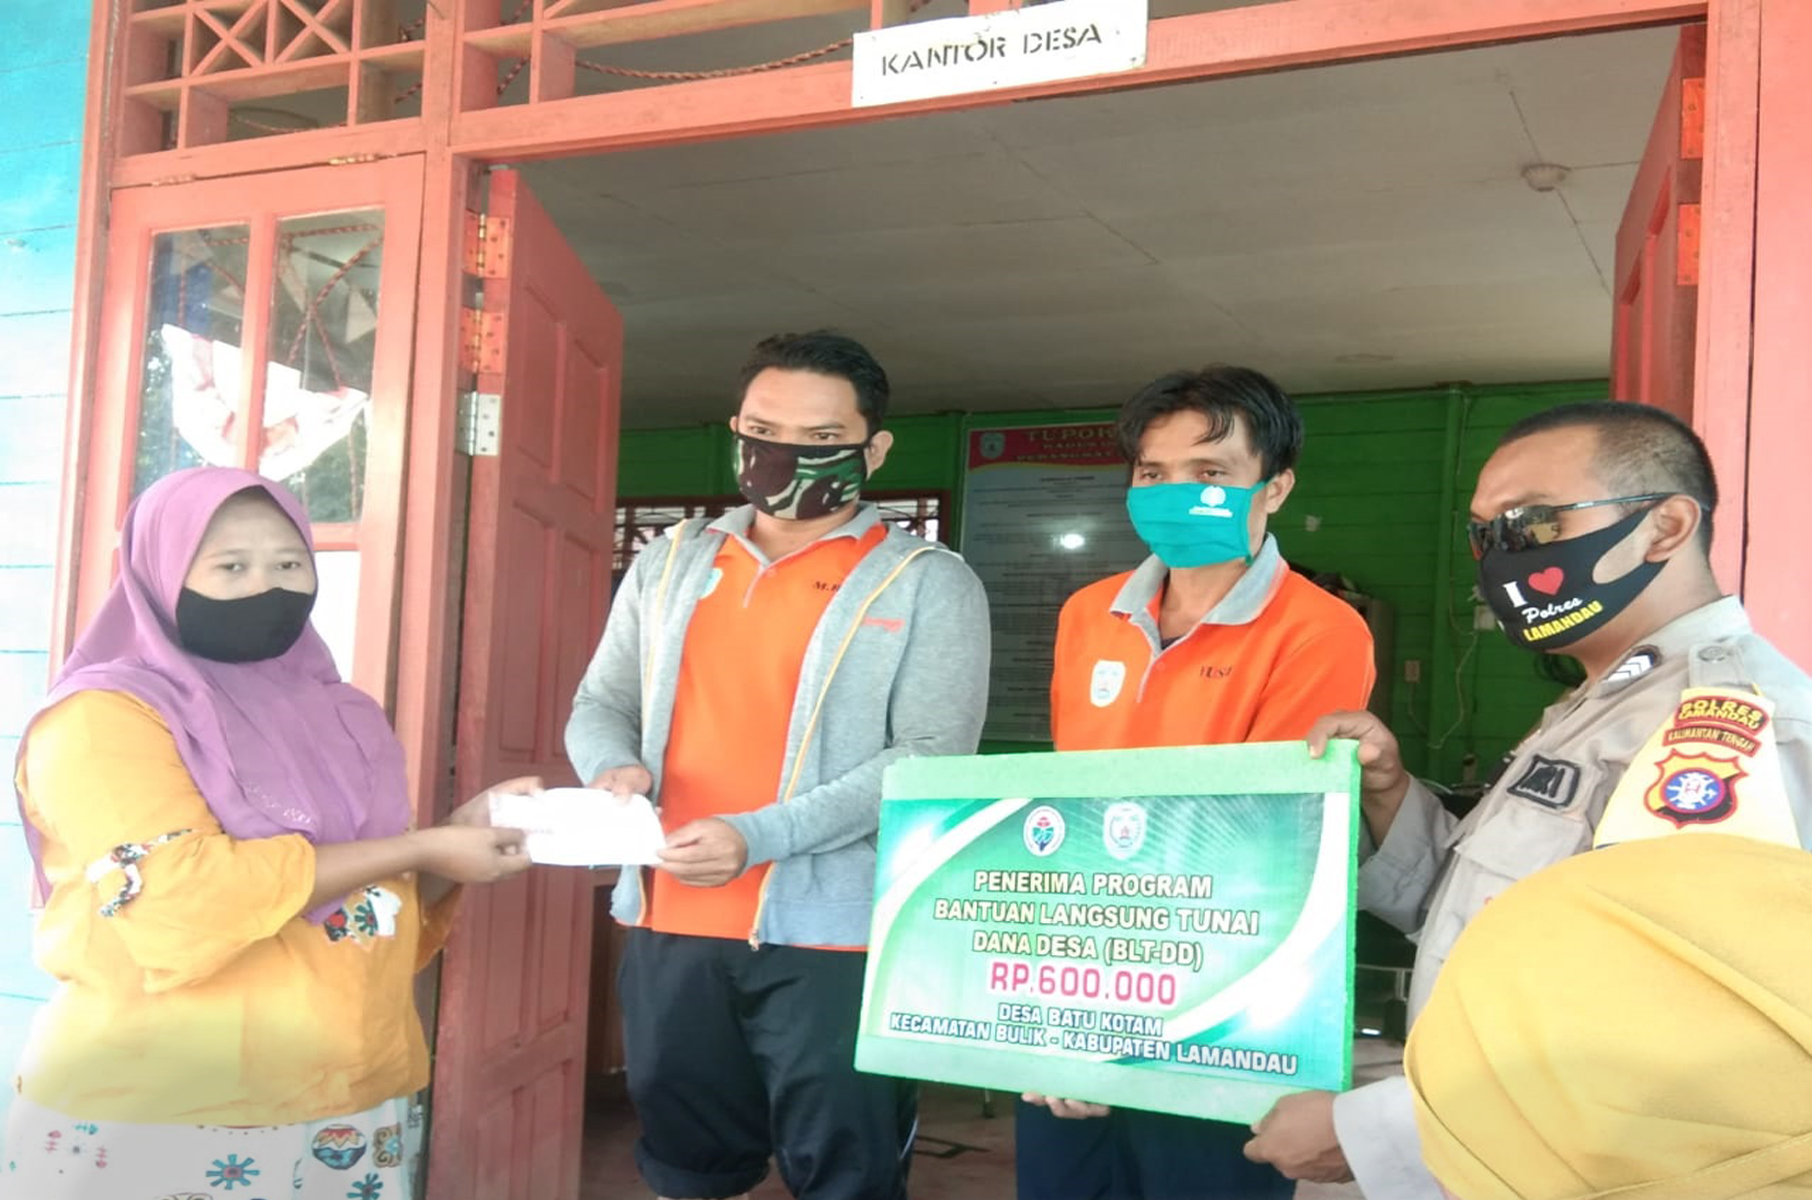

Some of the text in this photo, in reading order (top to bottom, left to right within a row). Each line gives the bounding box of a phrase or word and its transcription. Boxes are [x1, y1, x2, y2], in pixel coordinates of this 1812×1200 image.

[881, 23, 1102, 76] KANTOR DESA
[1502, 581, 1528, 608] I
[1521, 598, 1583, 624] Polres
[1522, 600, 1603, 641] LAMANDAU
[1679, 699, 1763, 721] POLRES
[974, 871, 1212, 899] PENERIMA PROGRAM
[934, 898, 1260, 935] BANTUAN LANGSUNG TUNAI
[972, 930, 1204, 973] DANA DESA (BLT-DD)
[990, 961, 1177, 1006] RP.600.000
[998, 1002, 1164, 1037] DESA BATU KOTAM
[889, 1012, 992, 1041] KECAMATAN
[995, 1023, 1047, 1047] BULIK
[1062, 1029, 1172, 1062] KABUPATEN
[1175, 1041, 1299, 1076] LAMANDAU
